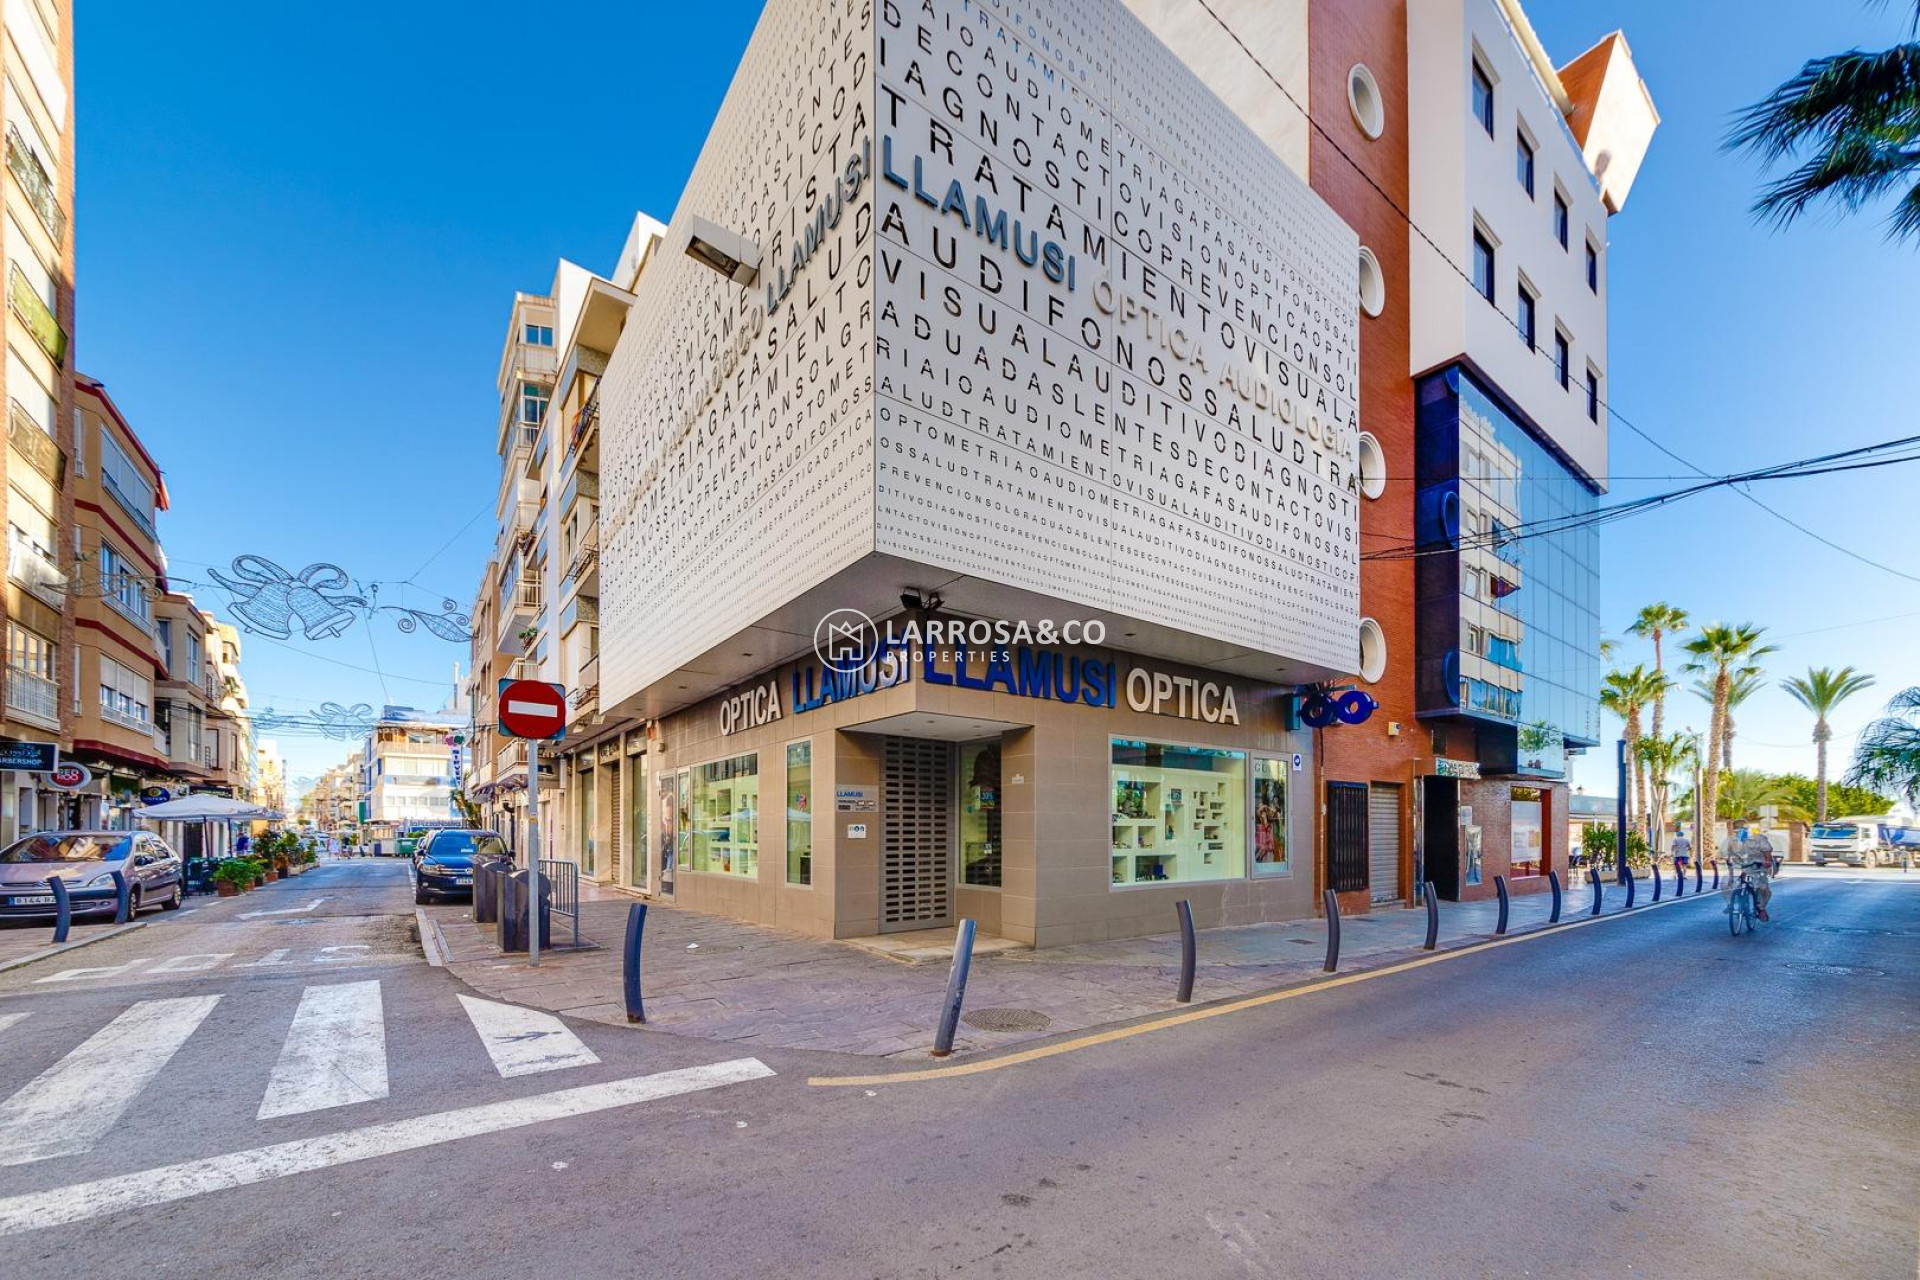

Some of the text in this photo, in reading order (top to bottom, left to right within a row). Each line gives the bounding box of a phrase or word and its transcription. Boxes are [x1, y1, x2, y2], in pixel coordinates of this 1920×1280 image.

[767, 135, 871, 316] LLAMUSI
[881, 83, 1357, 434] TRATAMIENTOVISUALA
[882, 133, 1076, 292] LLAMUSI
[719, 680, 783, 737] OPTICA
[791, 628, 912, 715] LLAMUSI
[923, 630, 1116, 709] LLAMUSI
[1125, 667, 1240, 725] OPTICA
